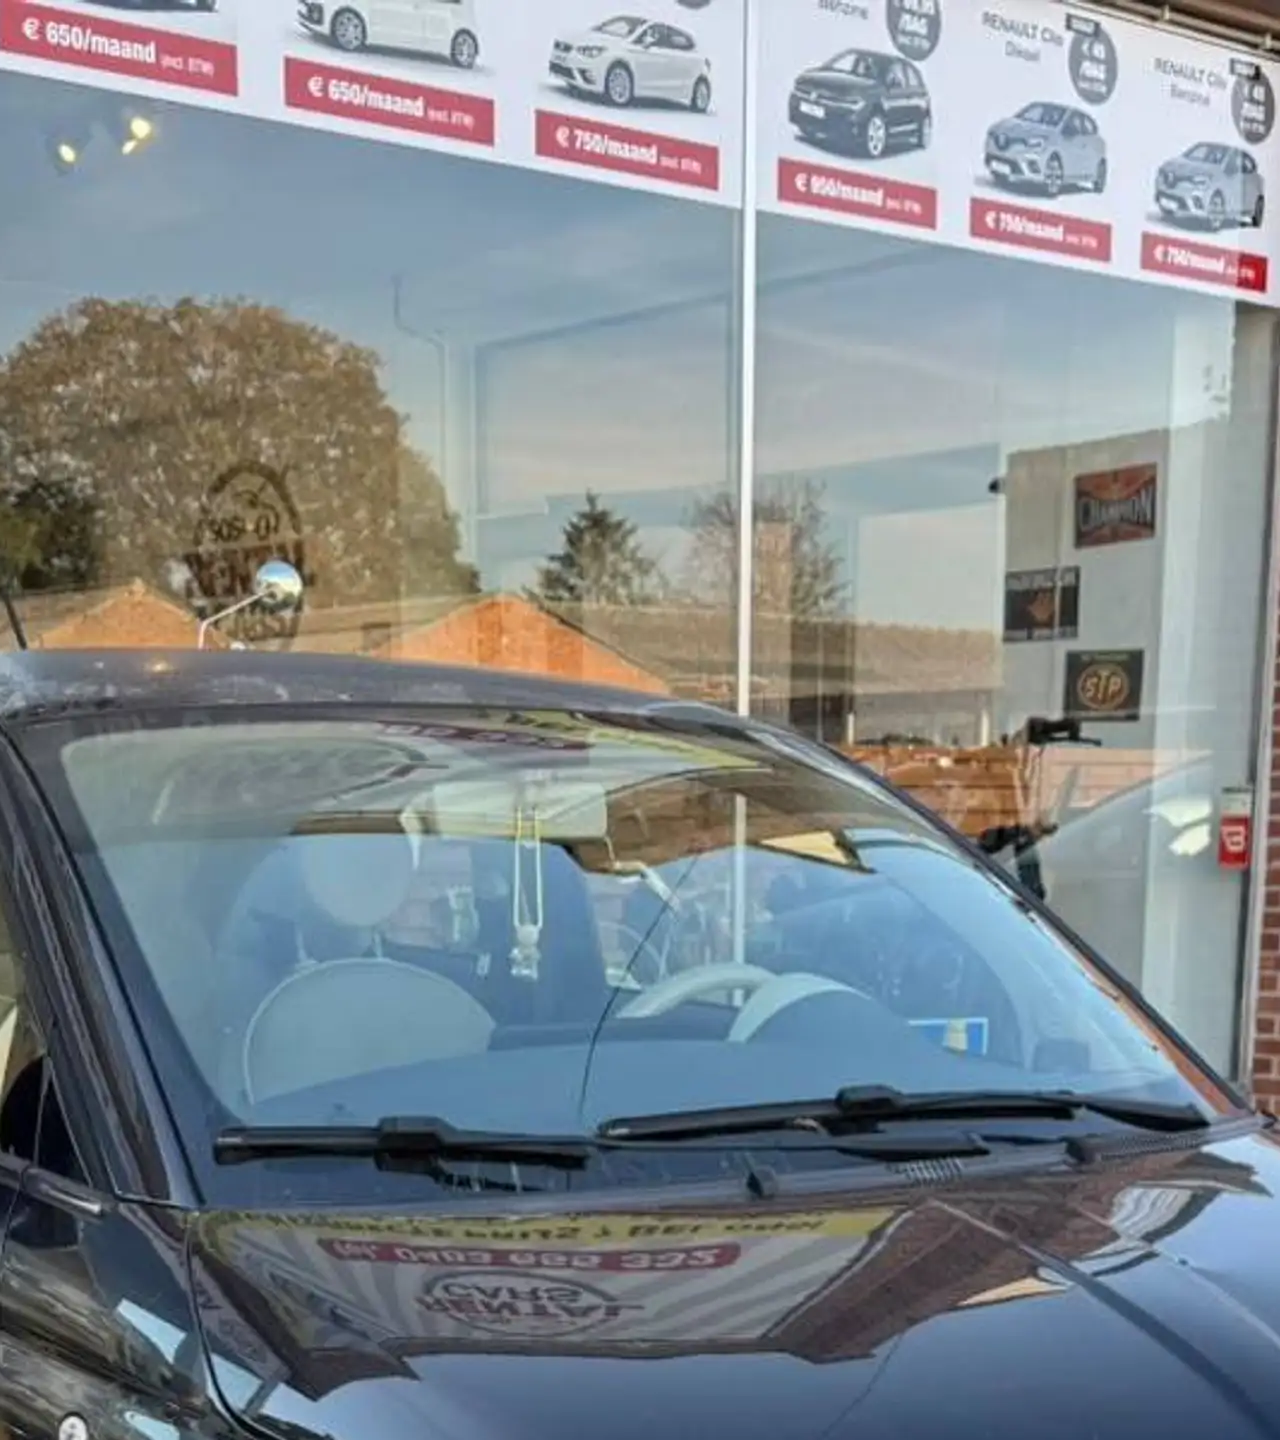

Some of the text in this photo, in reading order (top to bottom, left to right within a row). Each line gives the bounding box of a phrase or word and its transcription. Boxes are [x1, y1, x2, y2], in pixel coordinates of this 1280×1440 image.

[21, 17, 40, 40] €
[46, 20, 157, 63] 650/maand
[982, 11, 1063, 46] RENAULT Clio
[1154, 57, 1205, 83] RENAULT
[308, 76, 324, 97] €
[328, 78, 423, 117] 650/maand
[555, 125, 569, 148] €
[573, 128, 658, 164] 750/maand
[794, 172, 808, 192] €
[985, 210, 996, 230] €
[1153, 244, 1164, 264] €
[1078, 486, 1154, 532] CHAMPION
[1085, 669, 1122, 700] STP
